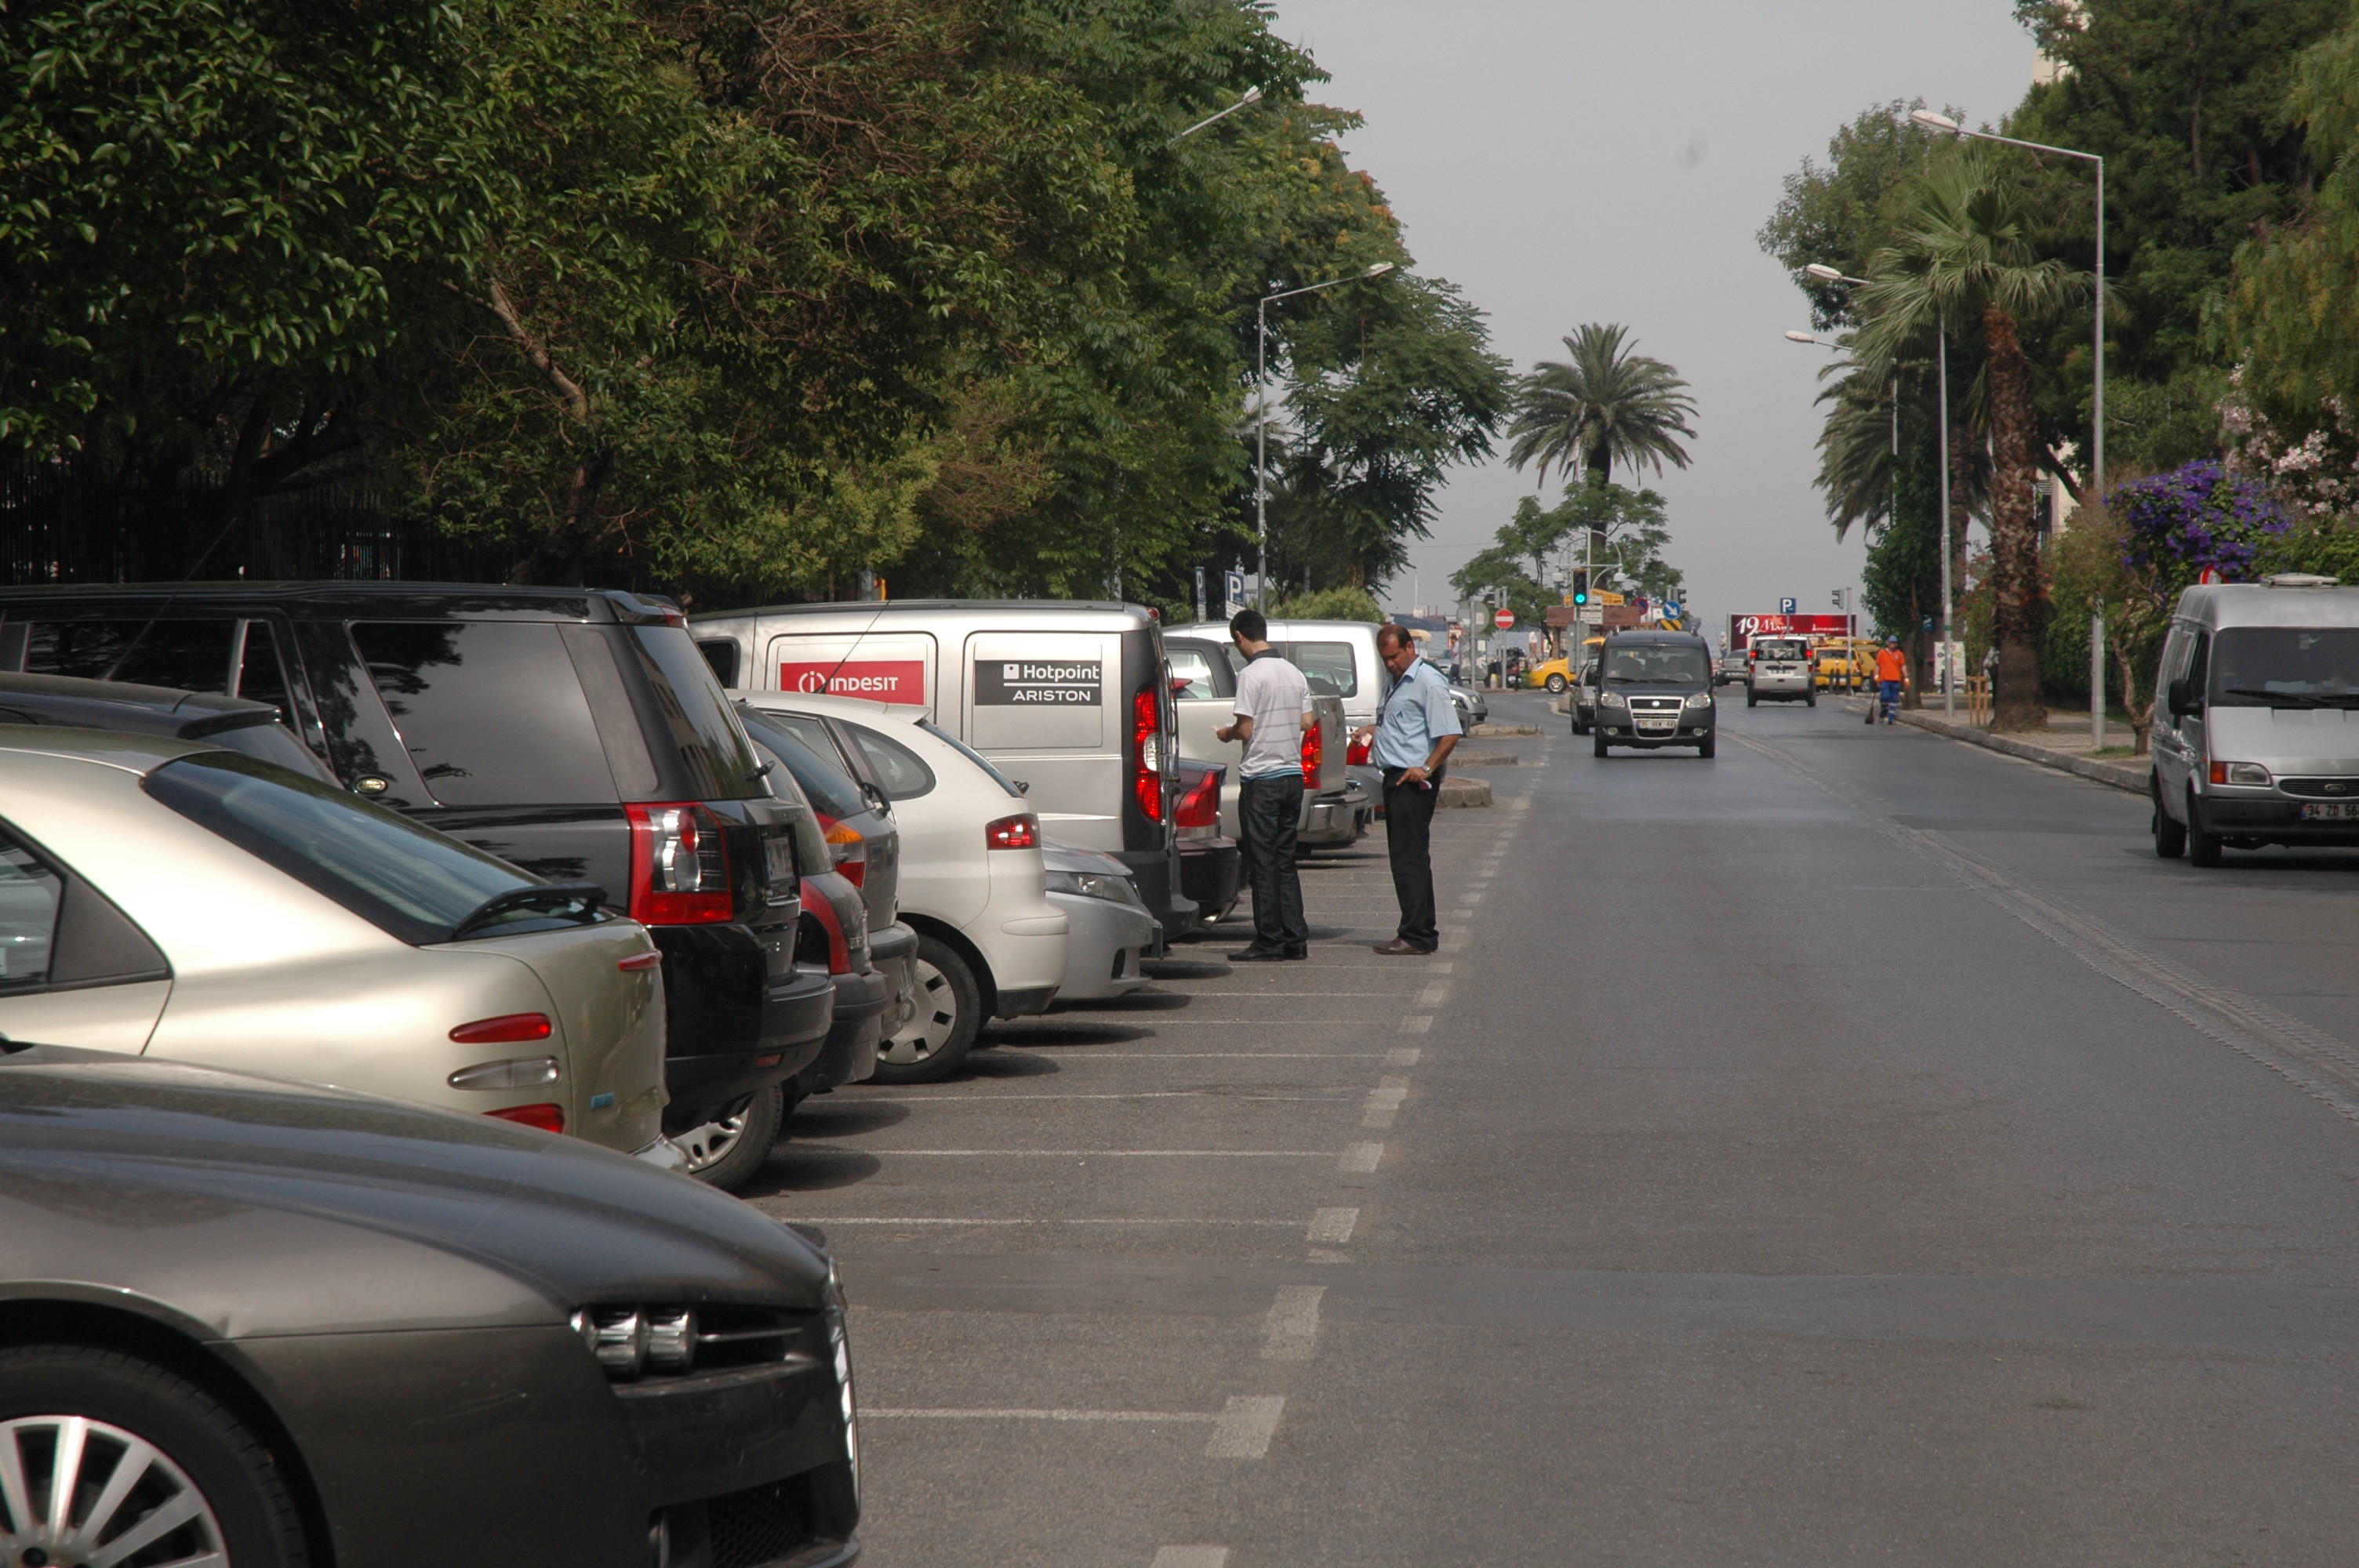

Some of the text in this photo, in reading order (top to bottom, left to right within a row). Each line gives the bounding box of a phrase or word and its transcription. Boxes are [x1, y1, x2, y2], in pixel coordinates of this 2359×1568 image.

[1197, 571, 1203, 599] P
[1229, 575, 1242, 602] P
[1783, 599, 1792, 612] P
[1736, 616, 1760, 637] 19
[1760, 619, 1794, 635] Mays
[1023, 664, 1100, 683] Hotpoint
[1012, 689, 1091, 702] ARISTON
[2308, 804, 2321, 816] 34
[2345, 804, 2359, 816] 56
